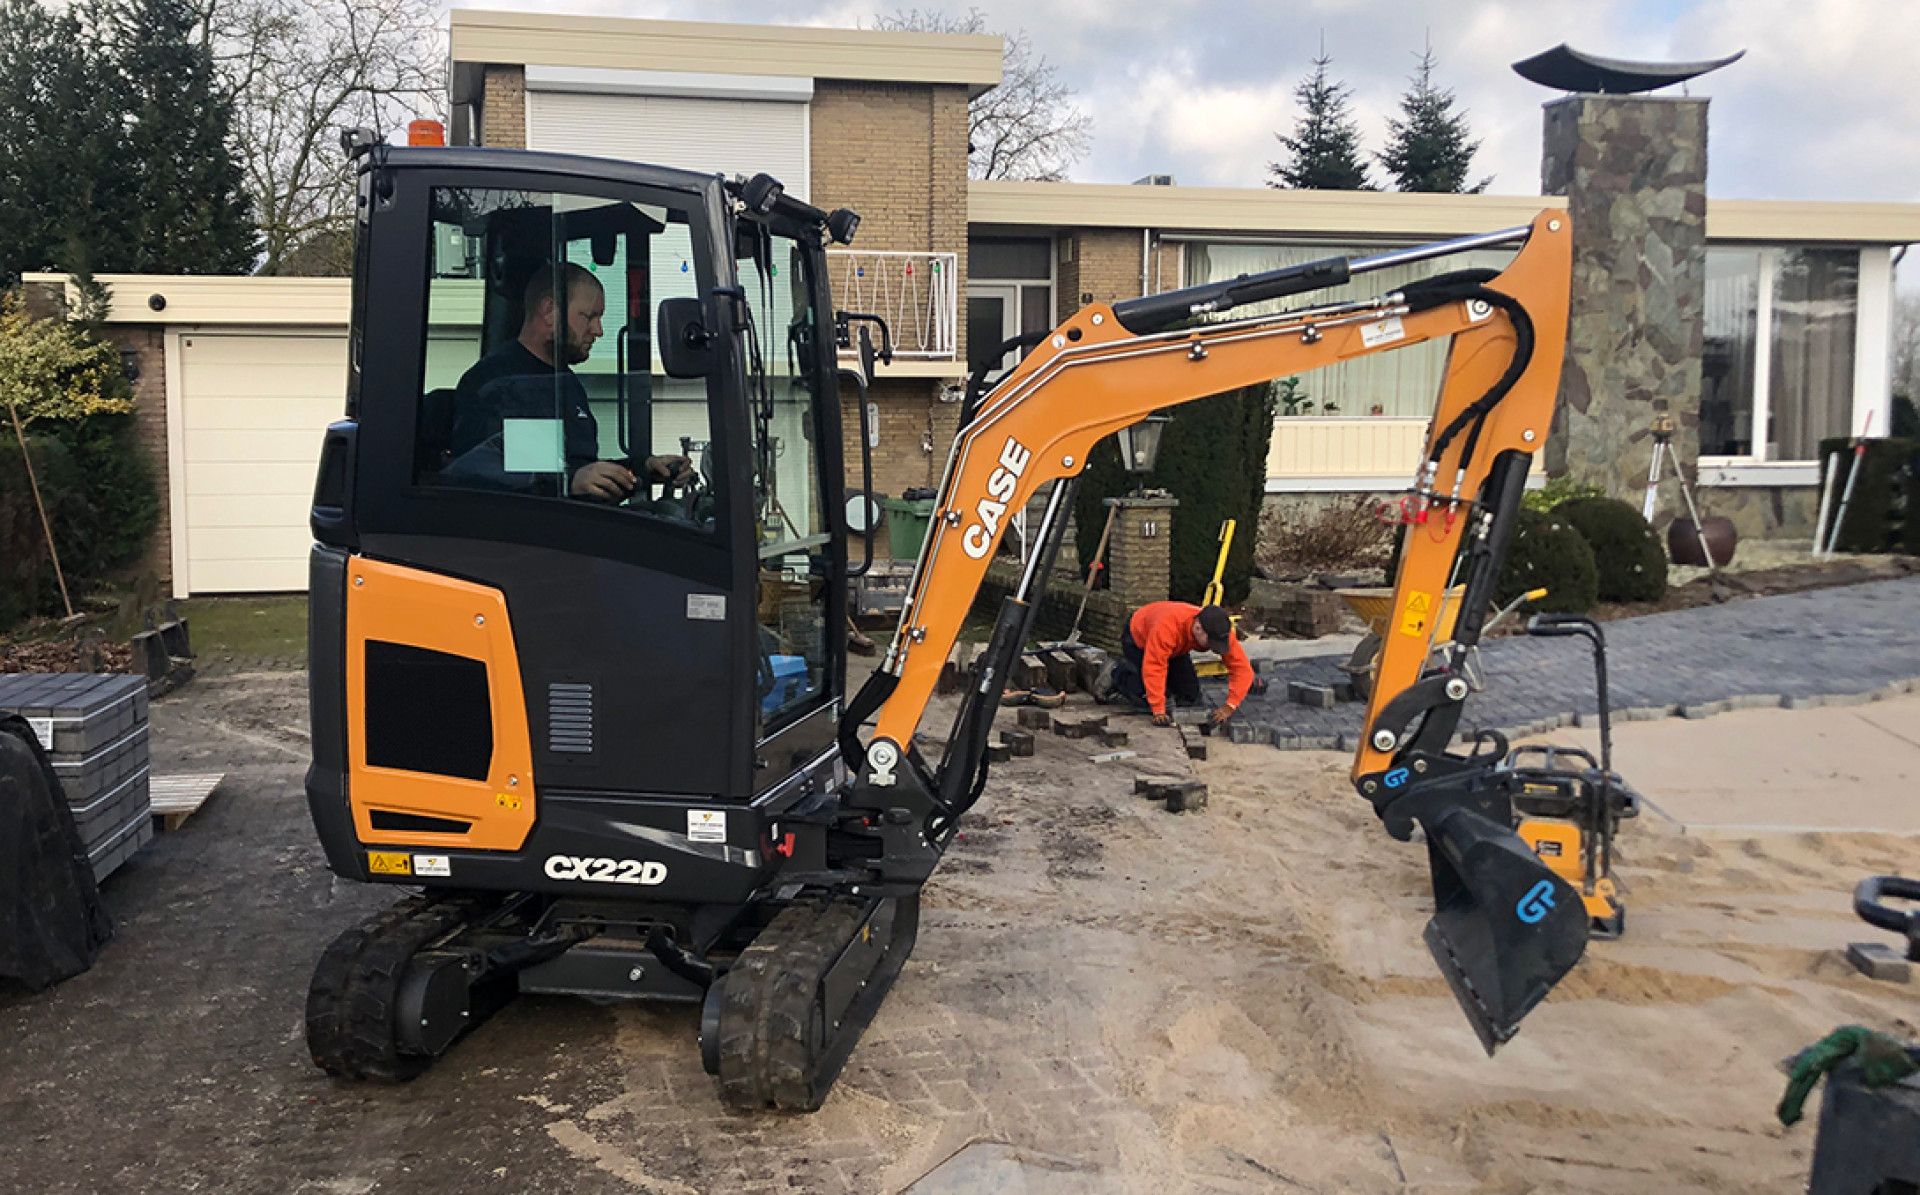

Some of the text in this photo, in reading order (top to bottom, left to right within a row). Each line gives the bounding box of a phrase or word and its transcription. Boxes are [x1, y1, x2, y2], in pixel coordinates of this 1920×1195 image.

[962, 436, 1032, 559] CASE
[1144, 521, 1156, 537] 11
[544, 854, 668, 885] CX22D
[1516, 879, 1556, 924] GP
